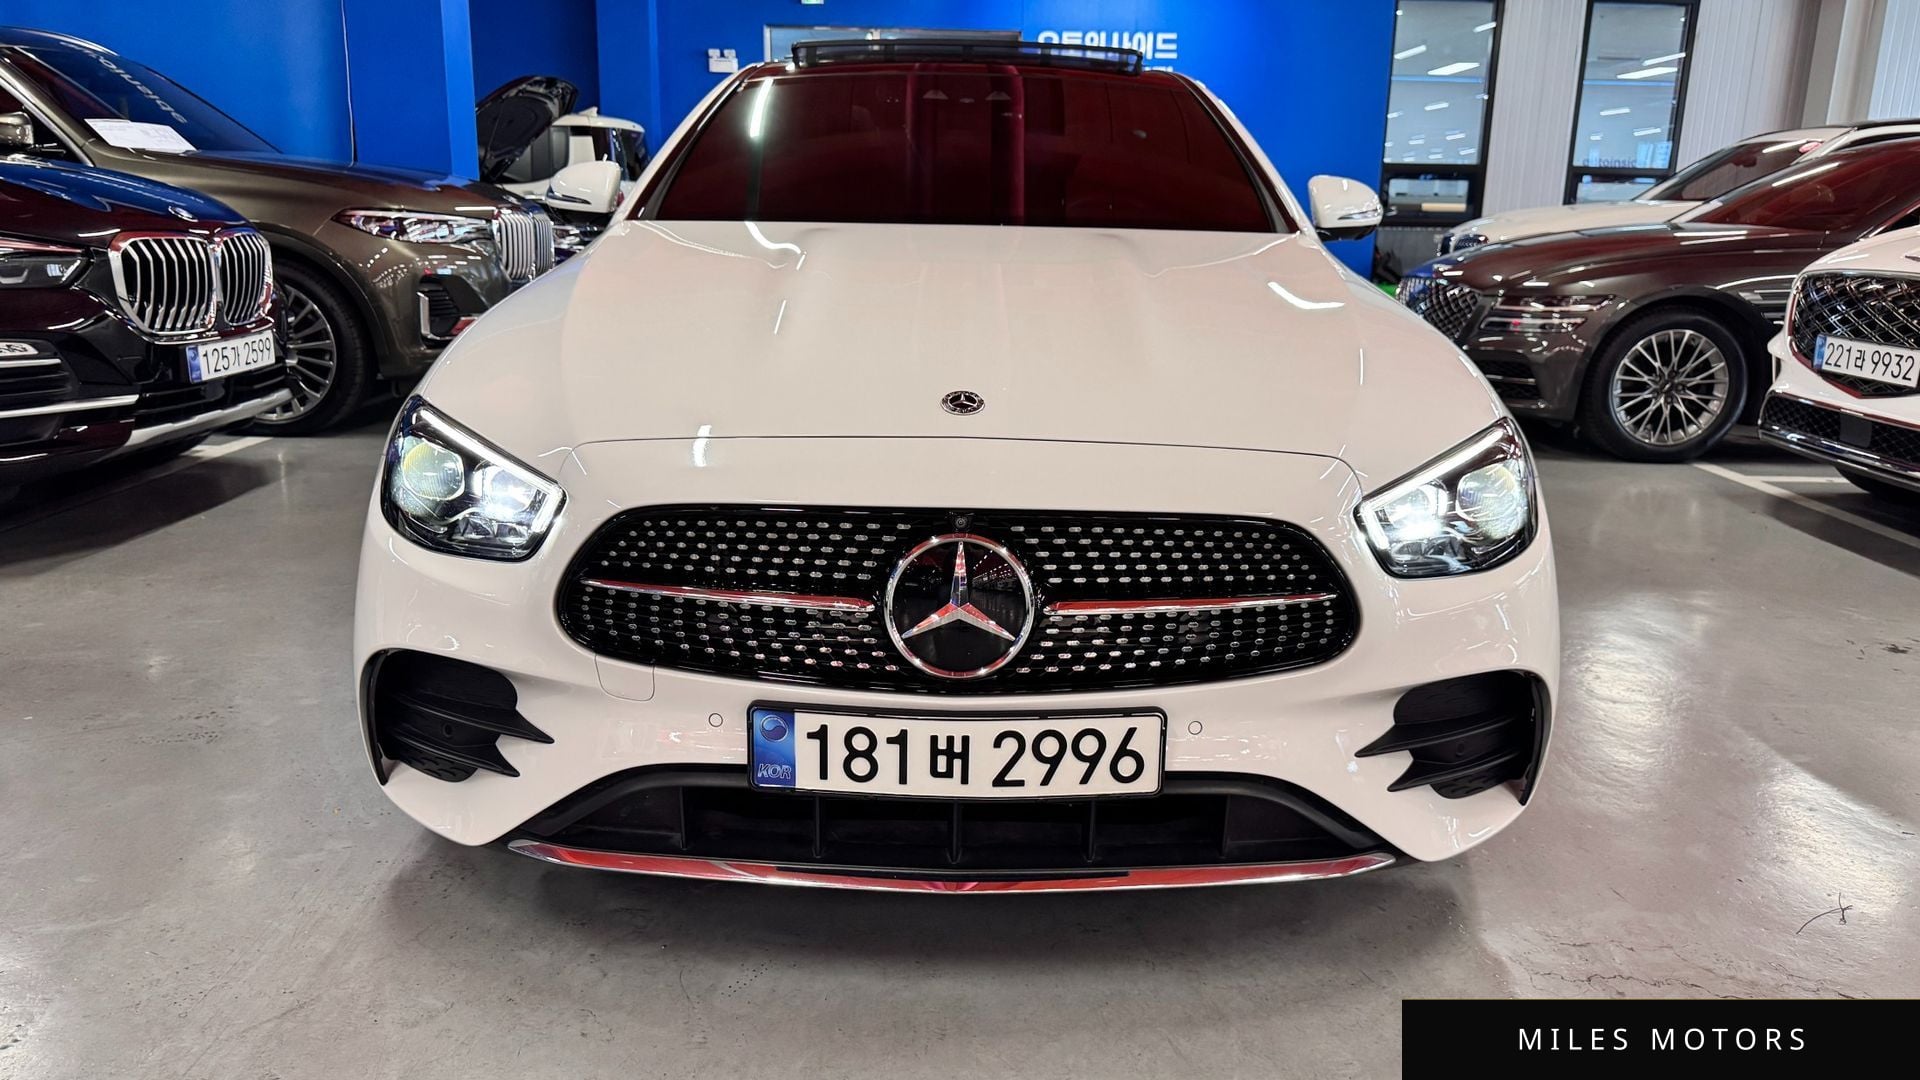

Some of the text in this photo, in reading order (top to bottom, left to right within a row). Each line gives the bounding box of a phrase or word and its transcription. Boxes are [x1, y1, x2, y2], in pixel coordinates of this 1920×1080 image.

[202, 337, 272, 375] 125가 2599
[1824, 342, 1915, 382] 221라 9932
[757, 763, 792, 780] KOR
[992, 727, 1145, 788] 2996
